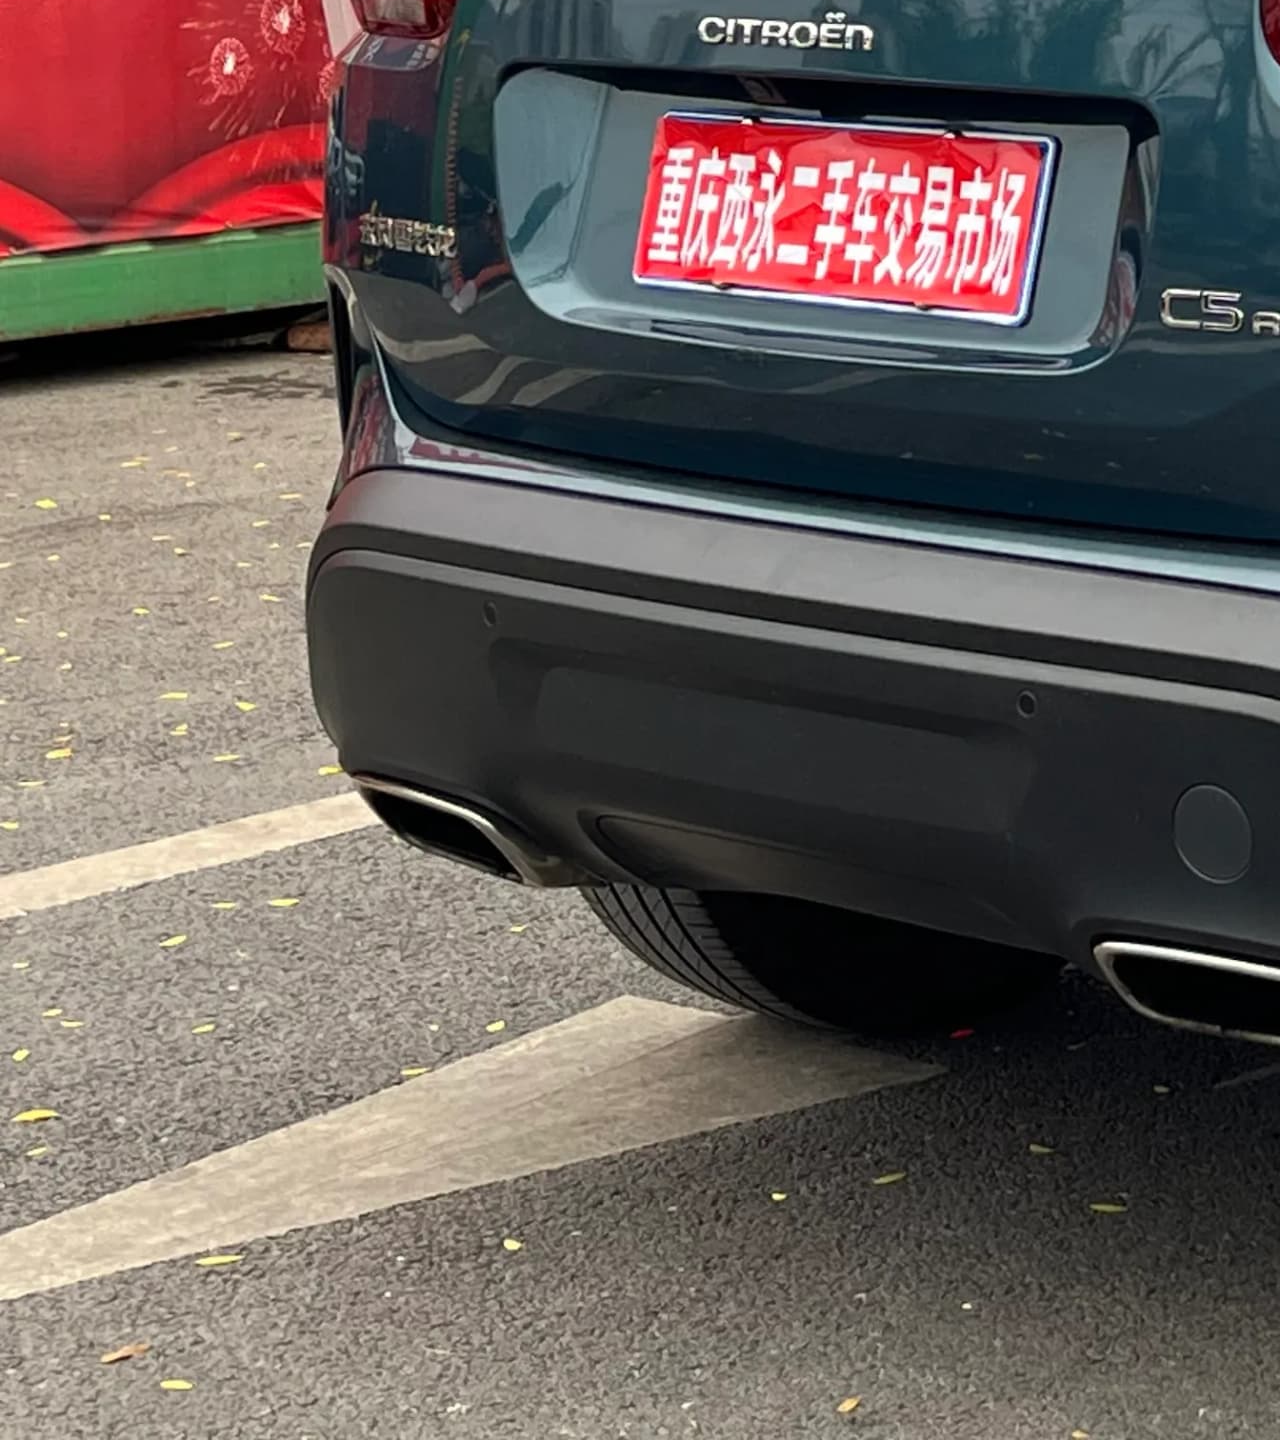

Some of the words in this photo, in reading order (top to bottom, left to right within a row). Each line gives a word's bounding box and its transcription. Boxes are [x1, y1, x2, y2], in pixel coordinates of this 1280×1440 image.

[698, 12, 874, 51] CITROËN
[648, 146, 1028, 296] 重庆西永二手车交易市场
[1160, 288, 1244, 332] C5
